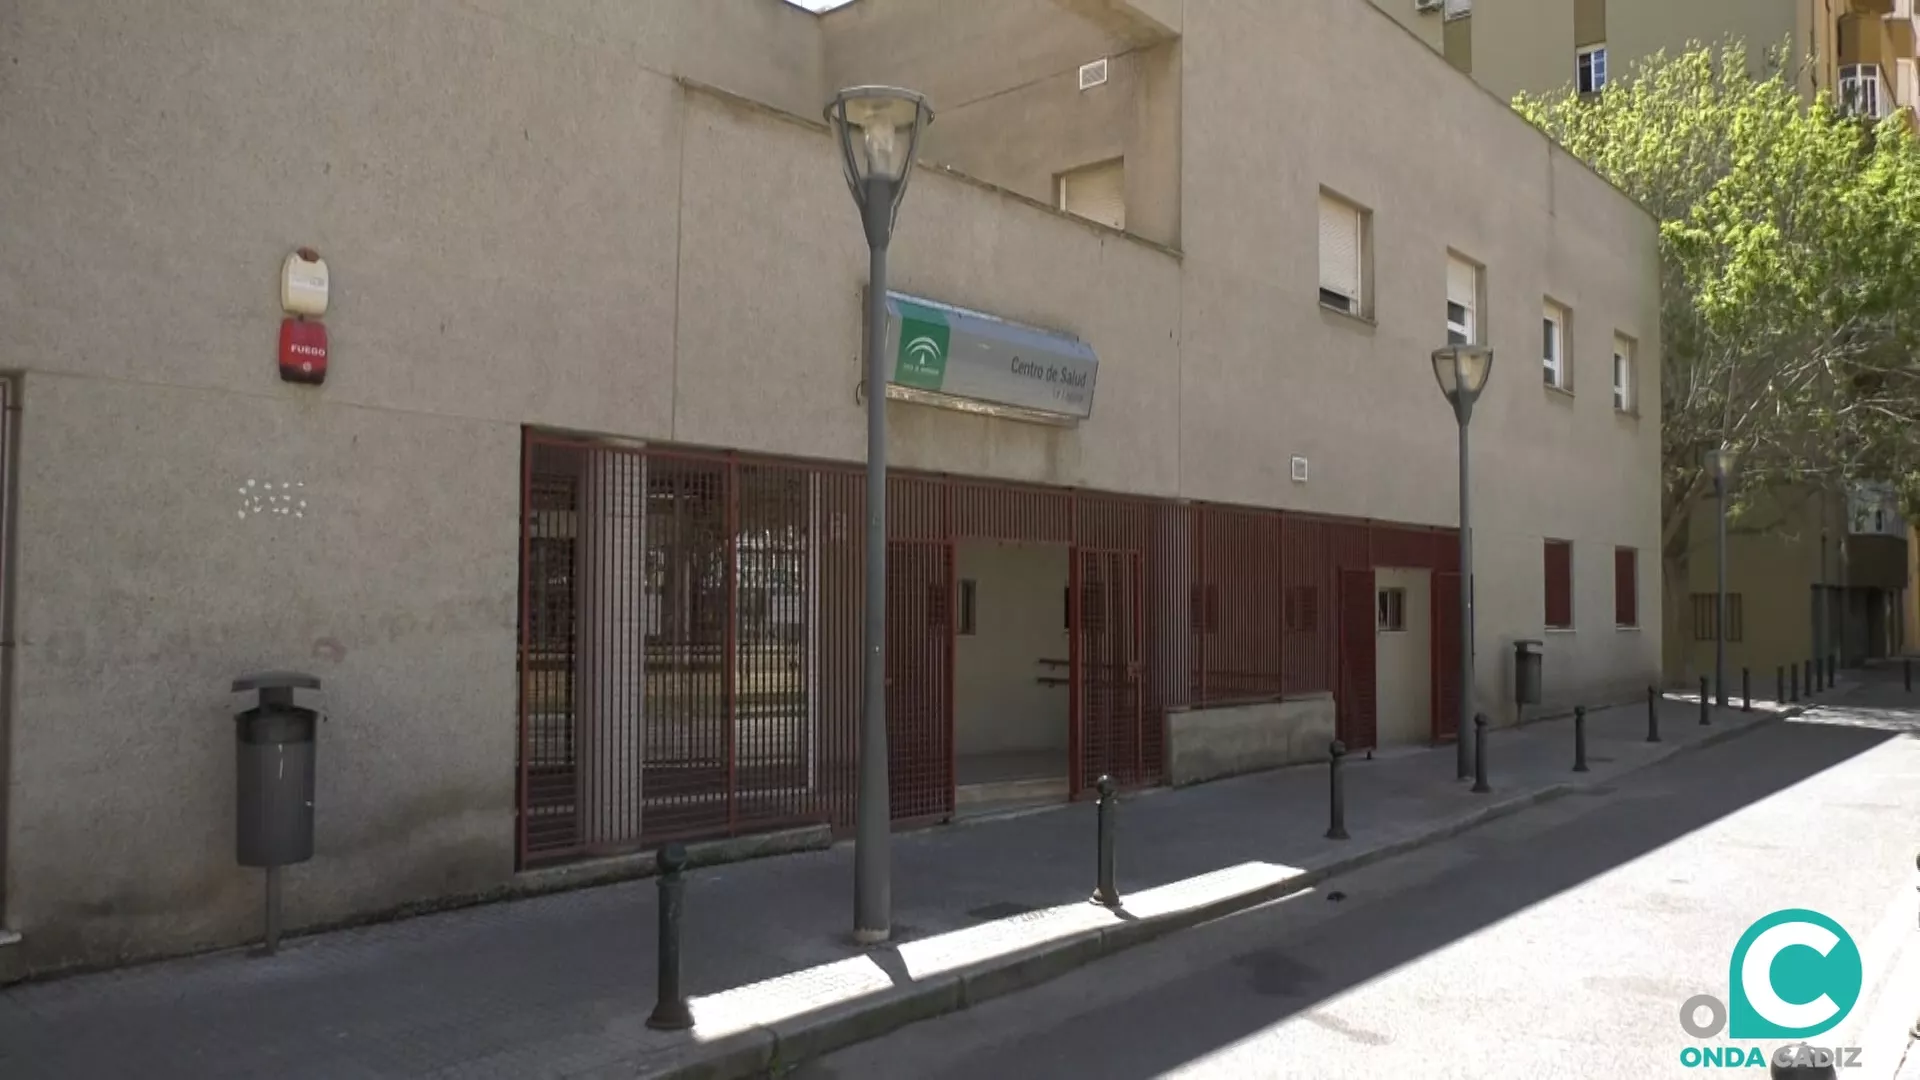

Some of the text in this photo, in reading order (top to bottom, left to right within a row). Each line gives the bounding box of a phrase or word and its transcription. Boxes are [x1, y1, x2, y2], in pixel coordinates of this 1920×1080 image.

[291, 343, 326, 357] FUEGO
[1011, 356, 1087, 387] Centro de Salud
